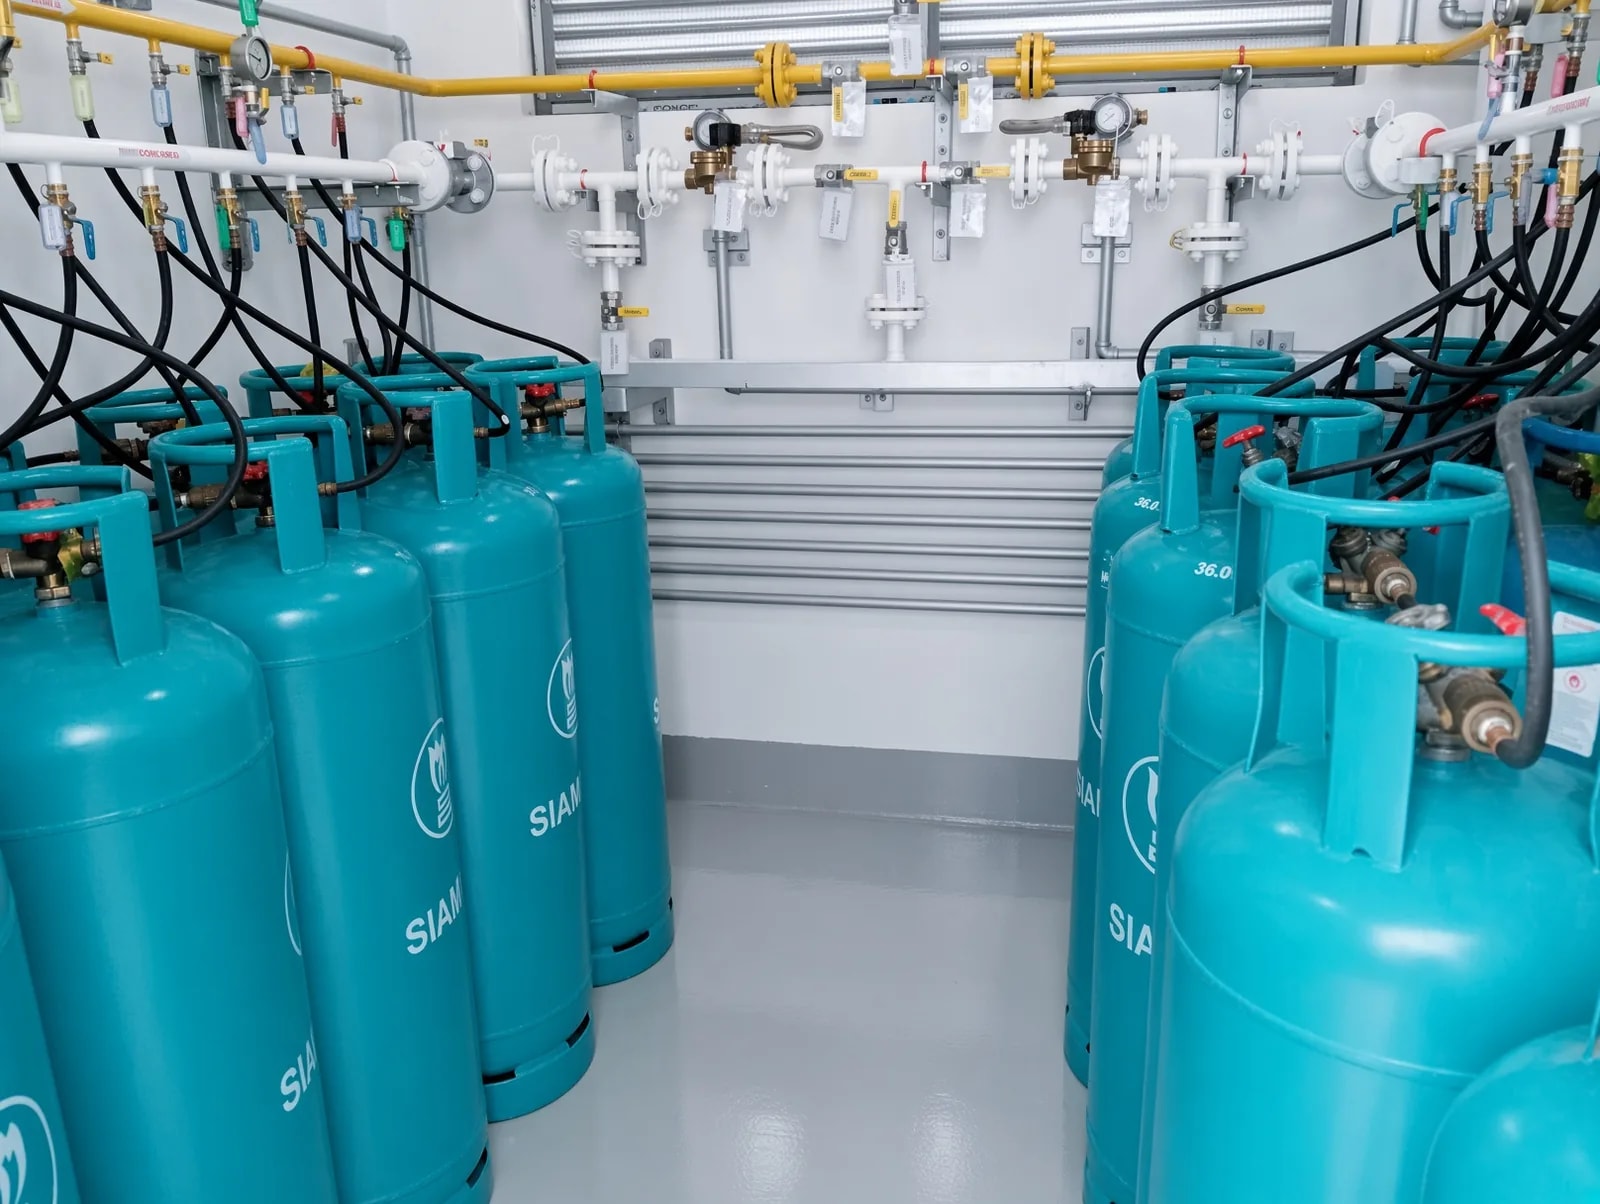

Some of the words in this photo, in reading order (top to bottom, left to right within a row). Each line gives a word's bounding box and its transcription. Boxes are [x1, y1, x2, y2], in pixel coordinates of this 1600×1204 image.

[1134, 497, 1160, 511] 36.0
[1194, 562, 1233, 580] 36.0
[1076, 767, 1100, 818] SIA
